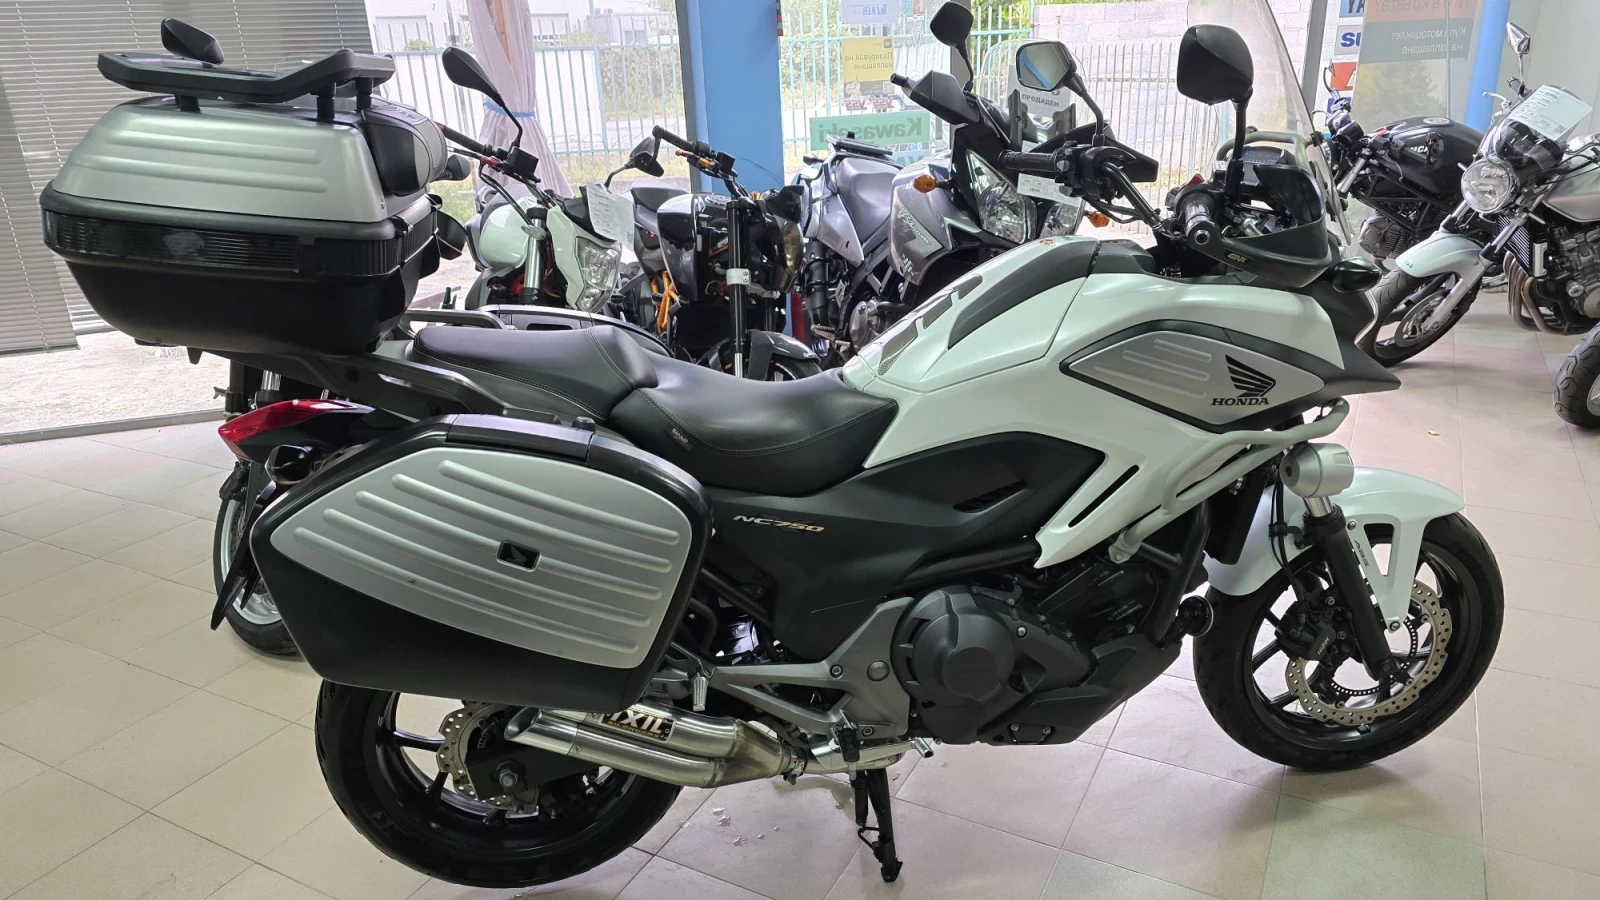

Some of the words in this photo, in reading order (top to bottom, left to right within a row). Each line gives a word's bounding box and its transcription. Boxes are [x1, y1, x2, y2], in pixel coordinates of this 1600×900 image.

[1021, 93, 1060, 107] ПРОДАДЕН
[1210, 398, 1270, 406] HONDA
[733, 515, 825, 532] NC750
[1354, 540, 1370, 567] ABS
[610, 708, 664, 734] IXIL
